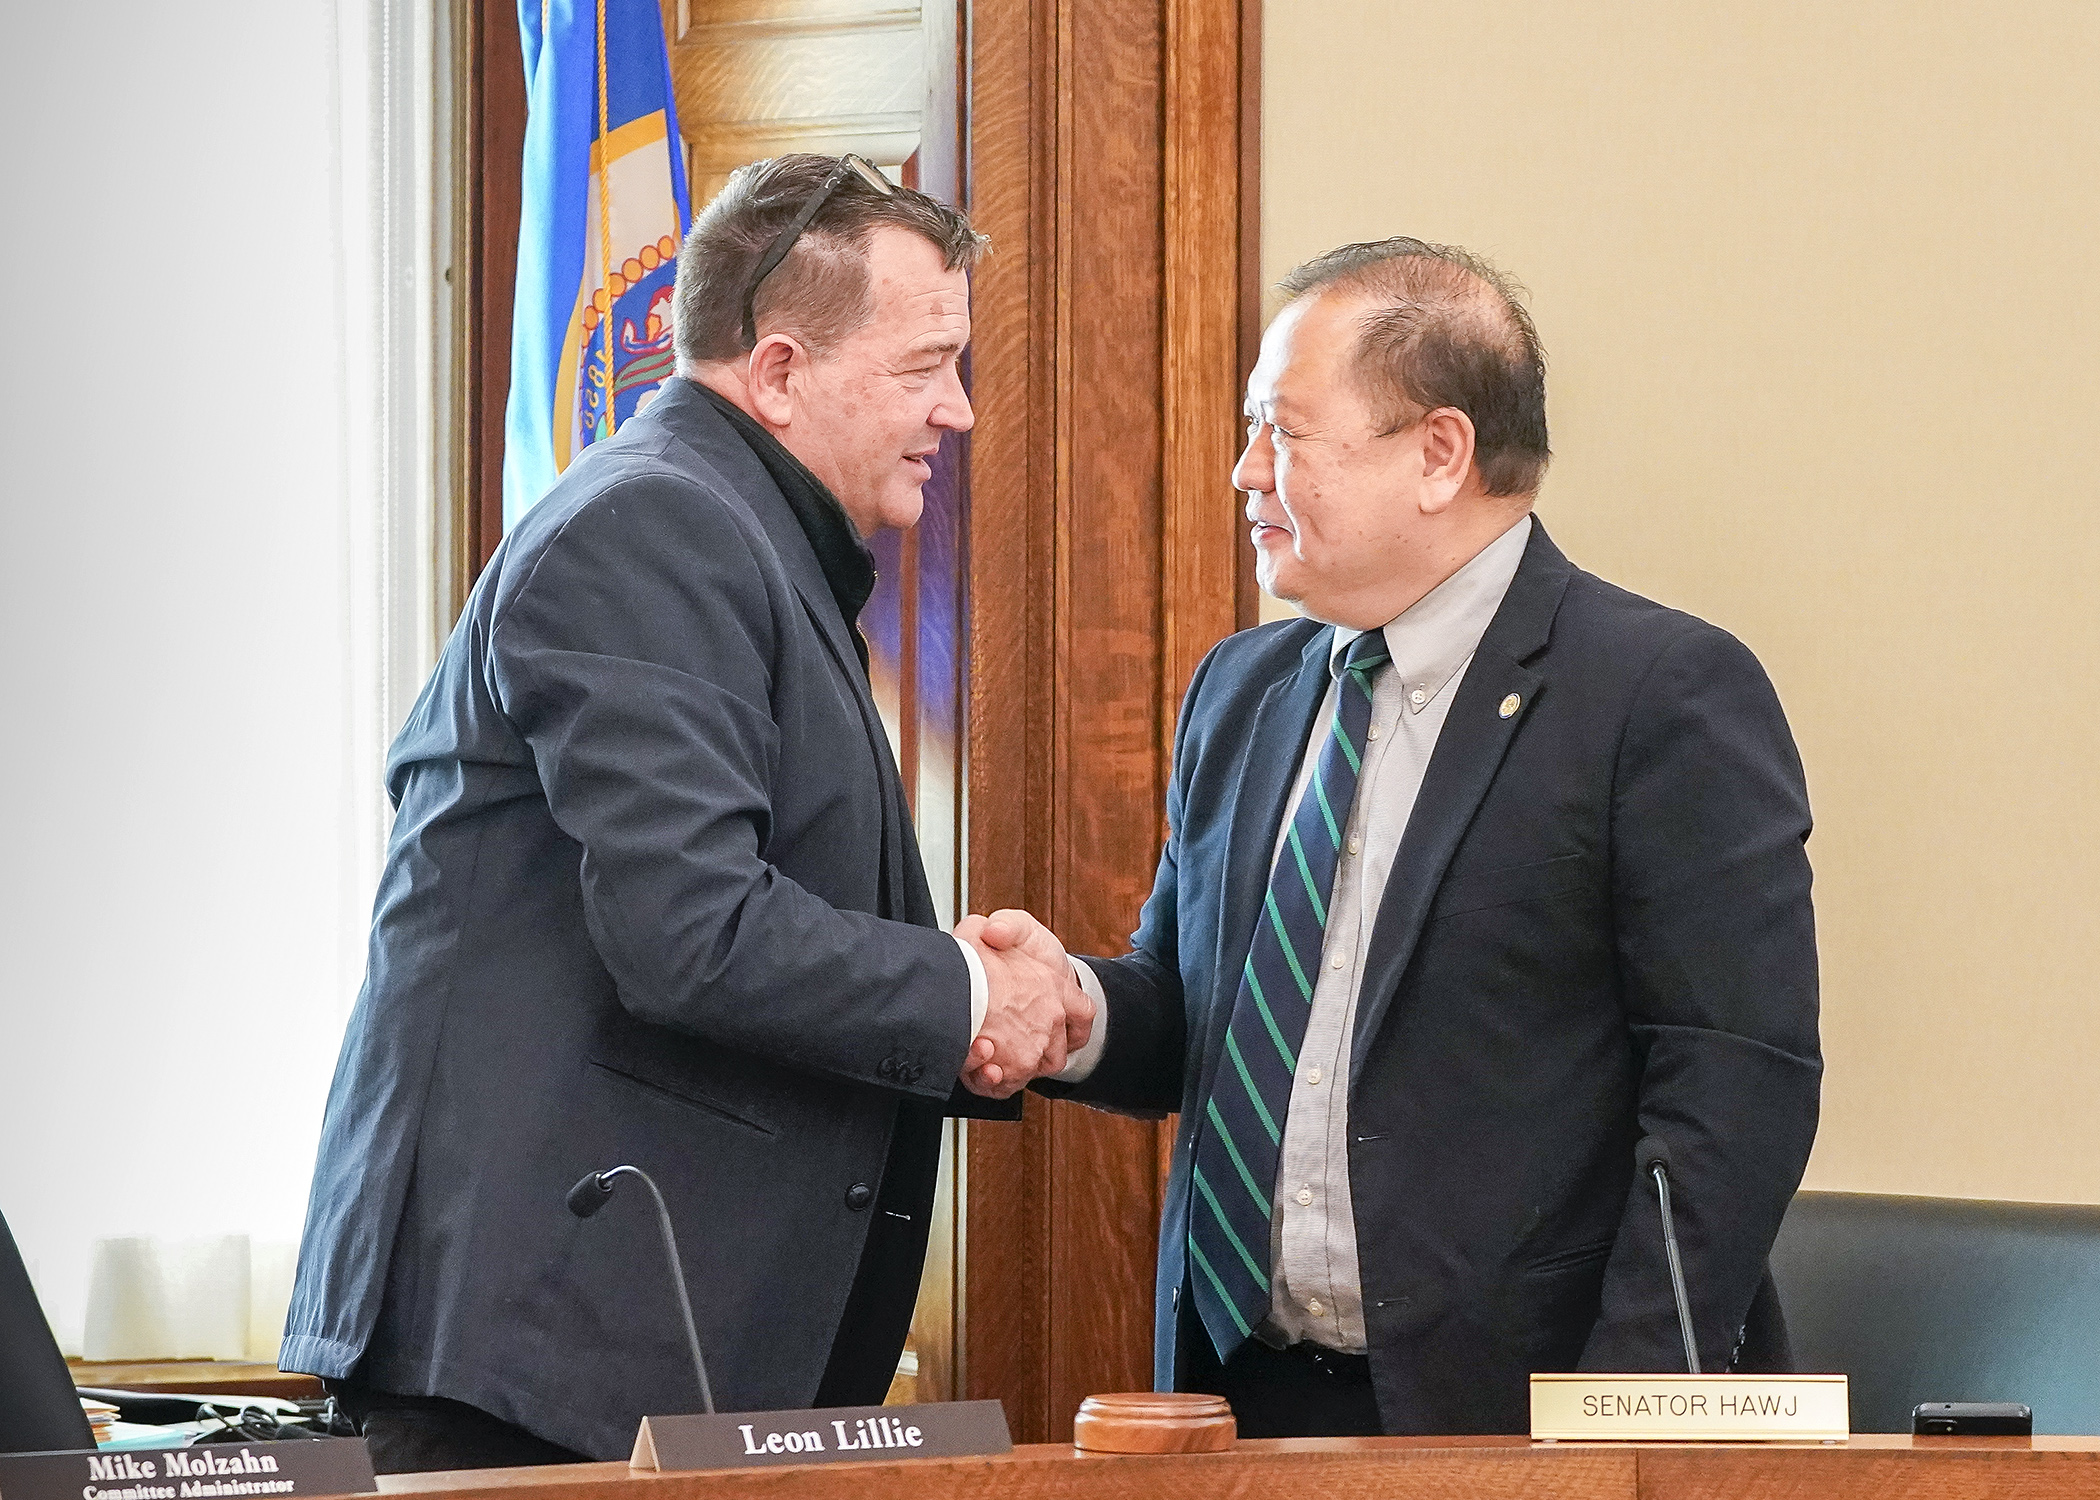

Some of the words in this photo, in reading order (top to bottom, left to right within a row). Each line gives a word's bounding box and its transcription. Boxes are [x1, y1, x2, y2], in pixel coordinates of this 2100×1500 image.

[1583, 1394, 1708, 1417] SENATOR
[1720, 1394, 1798, 1417] HAWJ
[738, 1424, 826, 1455] Leon
[830, 1416, 924, 1451] Lillie
[87, 1453, 157, 1481] Mike
[162, 1448, 280, 1478] Molzahn
[82, 1483, 177, 1500] Committee
[179, 1479, 296, 1498] Administrator
